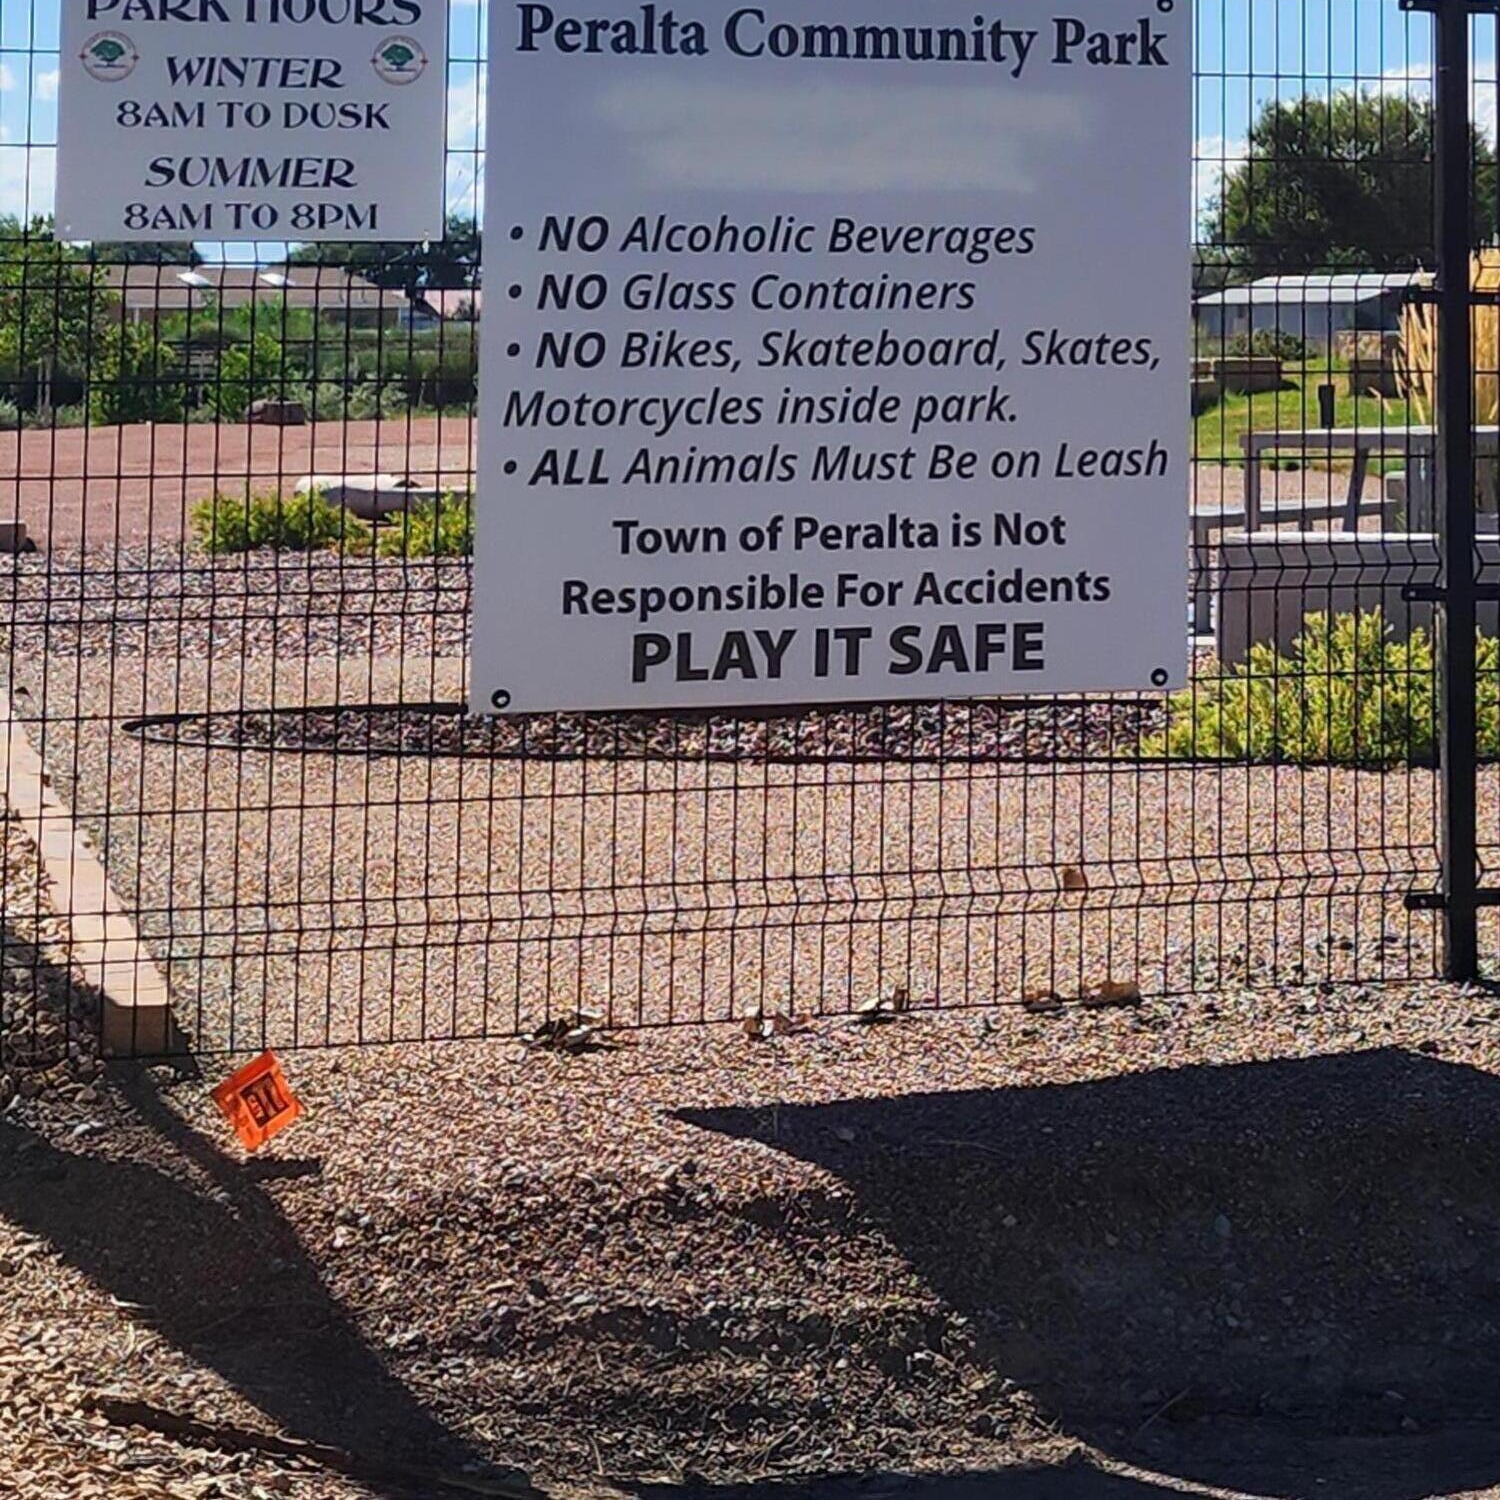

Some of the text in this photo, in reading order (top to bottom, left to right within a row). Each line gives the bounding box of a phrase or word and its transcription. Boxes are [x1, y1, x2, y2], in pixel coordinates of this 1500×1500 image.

[515, 3, 1169, 79] Peralta Community Park
[166, 56, 345, 89] WINTER
[116, 100, 390, 130] 8AM TO DUSK
[144, 156, 358, 188] SUMMER
[123, 203, 378, 230] 8AM TO 8PM
[538, 214, 1036, 265] NO Alcoholic Beverages
[537, 272, 976, 311] NO Glass Containers
[535, 328, 1160, 373] NO Bikes, Skateboard, Skates,
[503, 385, 1017, 438] Motorcycles inside park.
[527, 439, 1168, 486] ALL Animals Must Be on Leash
[612, 512, 1066, 555] Town of Peralta is Not
[562, 567, 1111, 623] Responsible For Accidents
[631, 621, 1045, 684] PLAY IT SAFE
